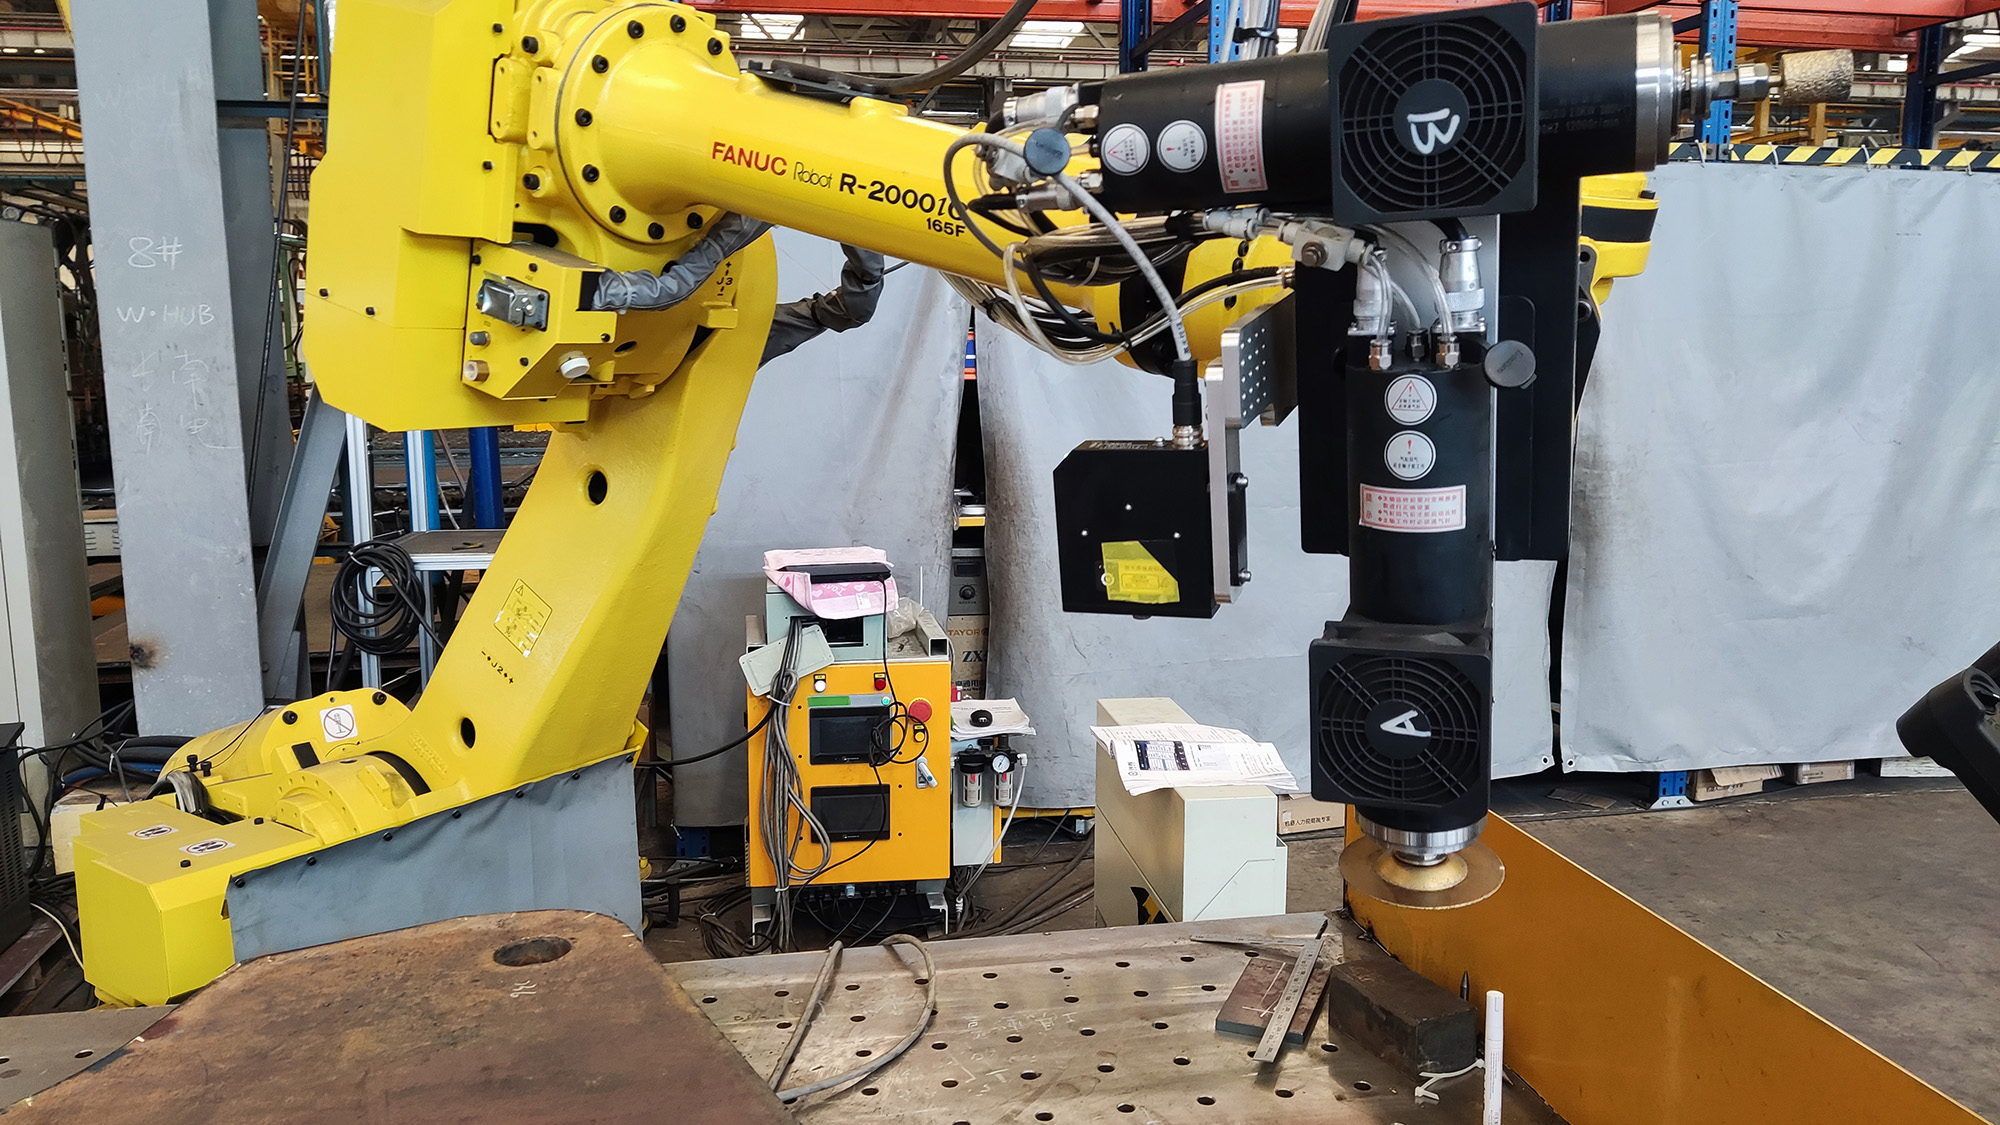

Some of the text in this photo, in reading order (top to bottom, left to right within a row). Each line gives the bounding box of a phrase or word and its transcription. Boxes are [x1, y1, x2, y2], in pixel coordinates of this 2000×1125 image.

[1406, 107, 1461, 155] B
[711, 141, 788, 176] FANUC
[793, 161, 833, 189] Robot
[926, 217, 966, 237] 165F
[127, 236, 183, 270] 8#
[716, 276, 734, 286] J3
[1380, 709, 1432, 738] A
